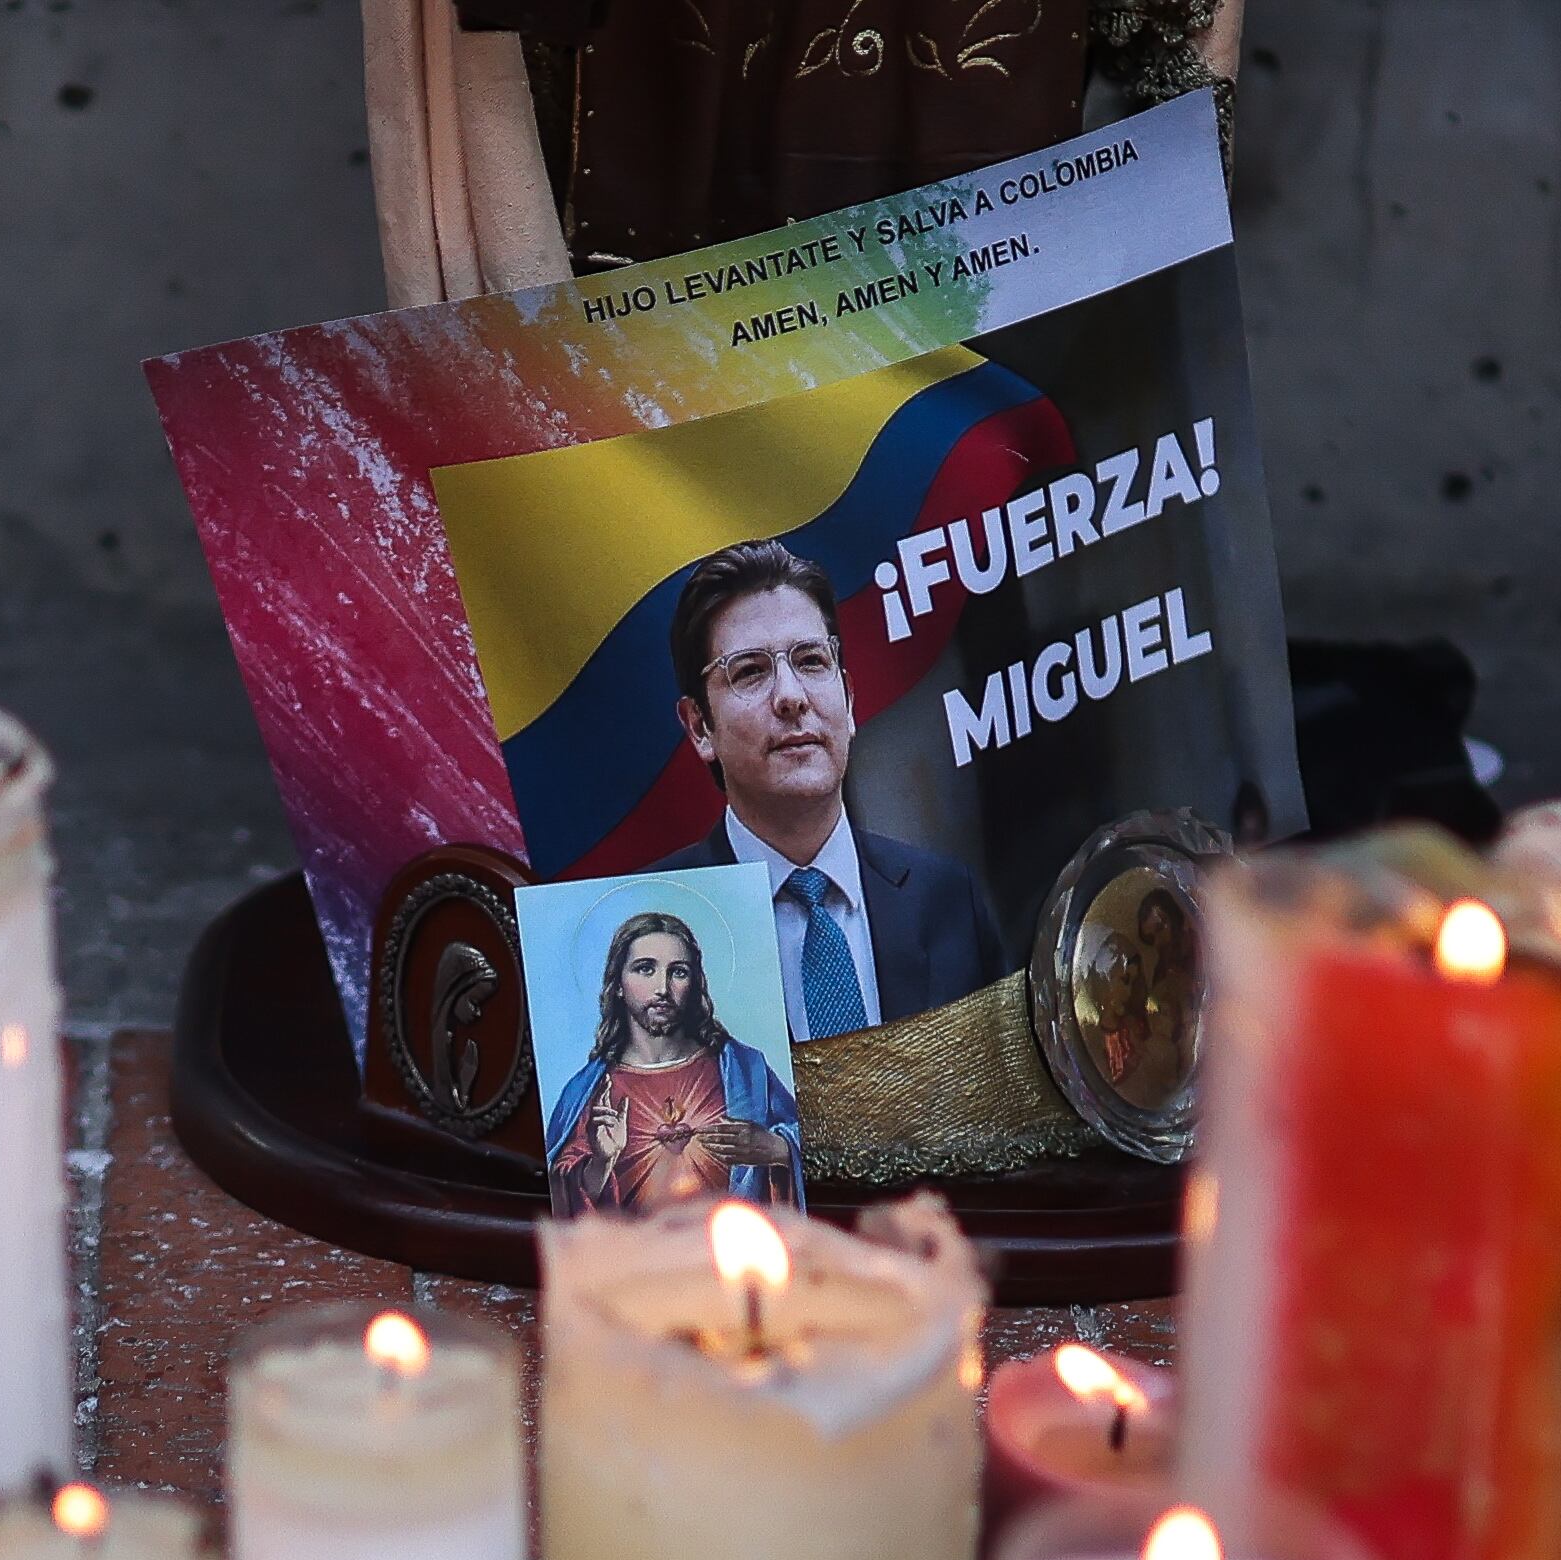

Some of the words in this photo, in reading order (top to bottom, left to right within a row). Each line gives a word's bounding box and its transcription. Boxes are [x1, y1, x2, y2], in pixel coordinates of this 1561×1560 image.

[582, 285, 657, 323] HIJO
[664, 235, 841, 304] LEVANTATE
[847, 227, 866, 252] Y
[877, 198, 968, 245] SALVA
[974, 188, 994, 215] A
[999, 139, 1138, 205] COLOMBIA
[731, 300, 828, 346] AMEN,
[836, 270, 919, 317] AMEN
[924, 261, 942, 287] Y
[952, 233, 1040, 282] AMEN.
[874, 417, 1221, 643] ¡FUERZA!
[943, 587, 1213, 767] MIGUEL
